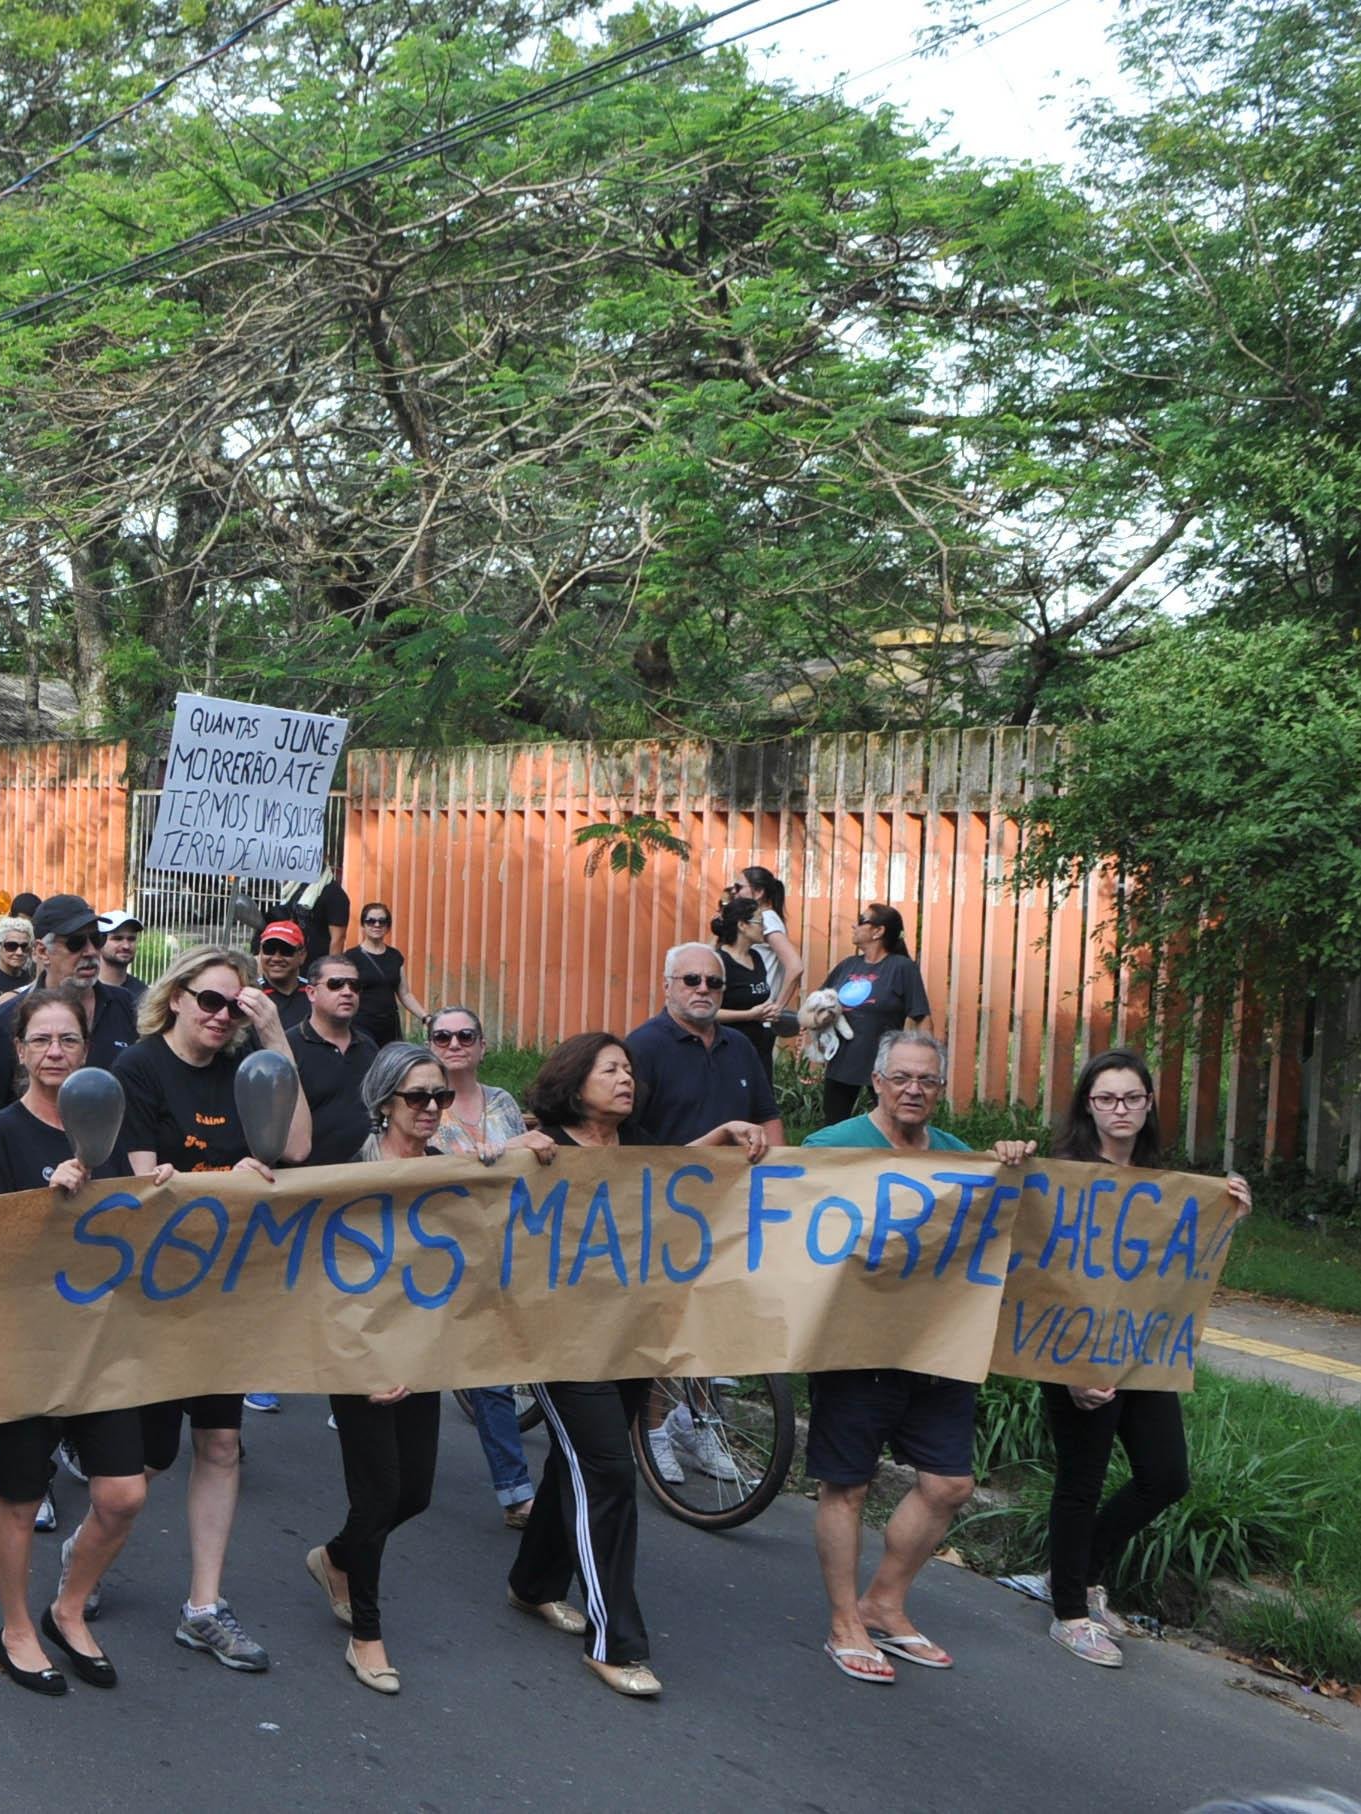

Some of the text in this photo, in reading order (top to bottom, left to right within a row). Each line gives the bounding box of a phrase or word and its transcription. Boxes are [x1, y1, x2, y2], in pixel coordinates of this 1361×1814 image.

[190, 708, 261, 740] QUANTAS
[169, 744, 326, 795] MORRERÃO ATÉ
[167, 789, 250, 831] TERMOS
[254, 797, 282, 836] UMA
[158, 830, 226, 869] TERRA
[228, 834, 257, 871] DE
[54, 1184, 471, 1309] SOMOS
[499, 1164, 713, 1291] MAIS
[1013, 1300, 1196, 1370] VIOLENCIA
